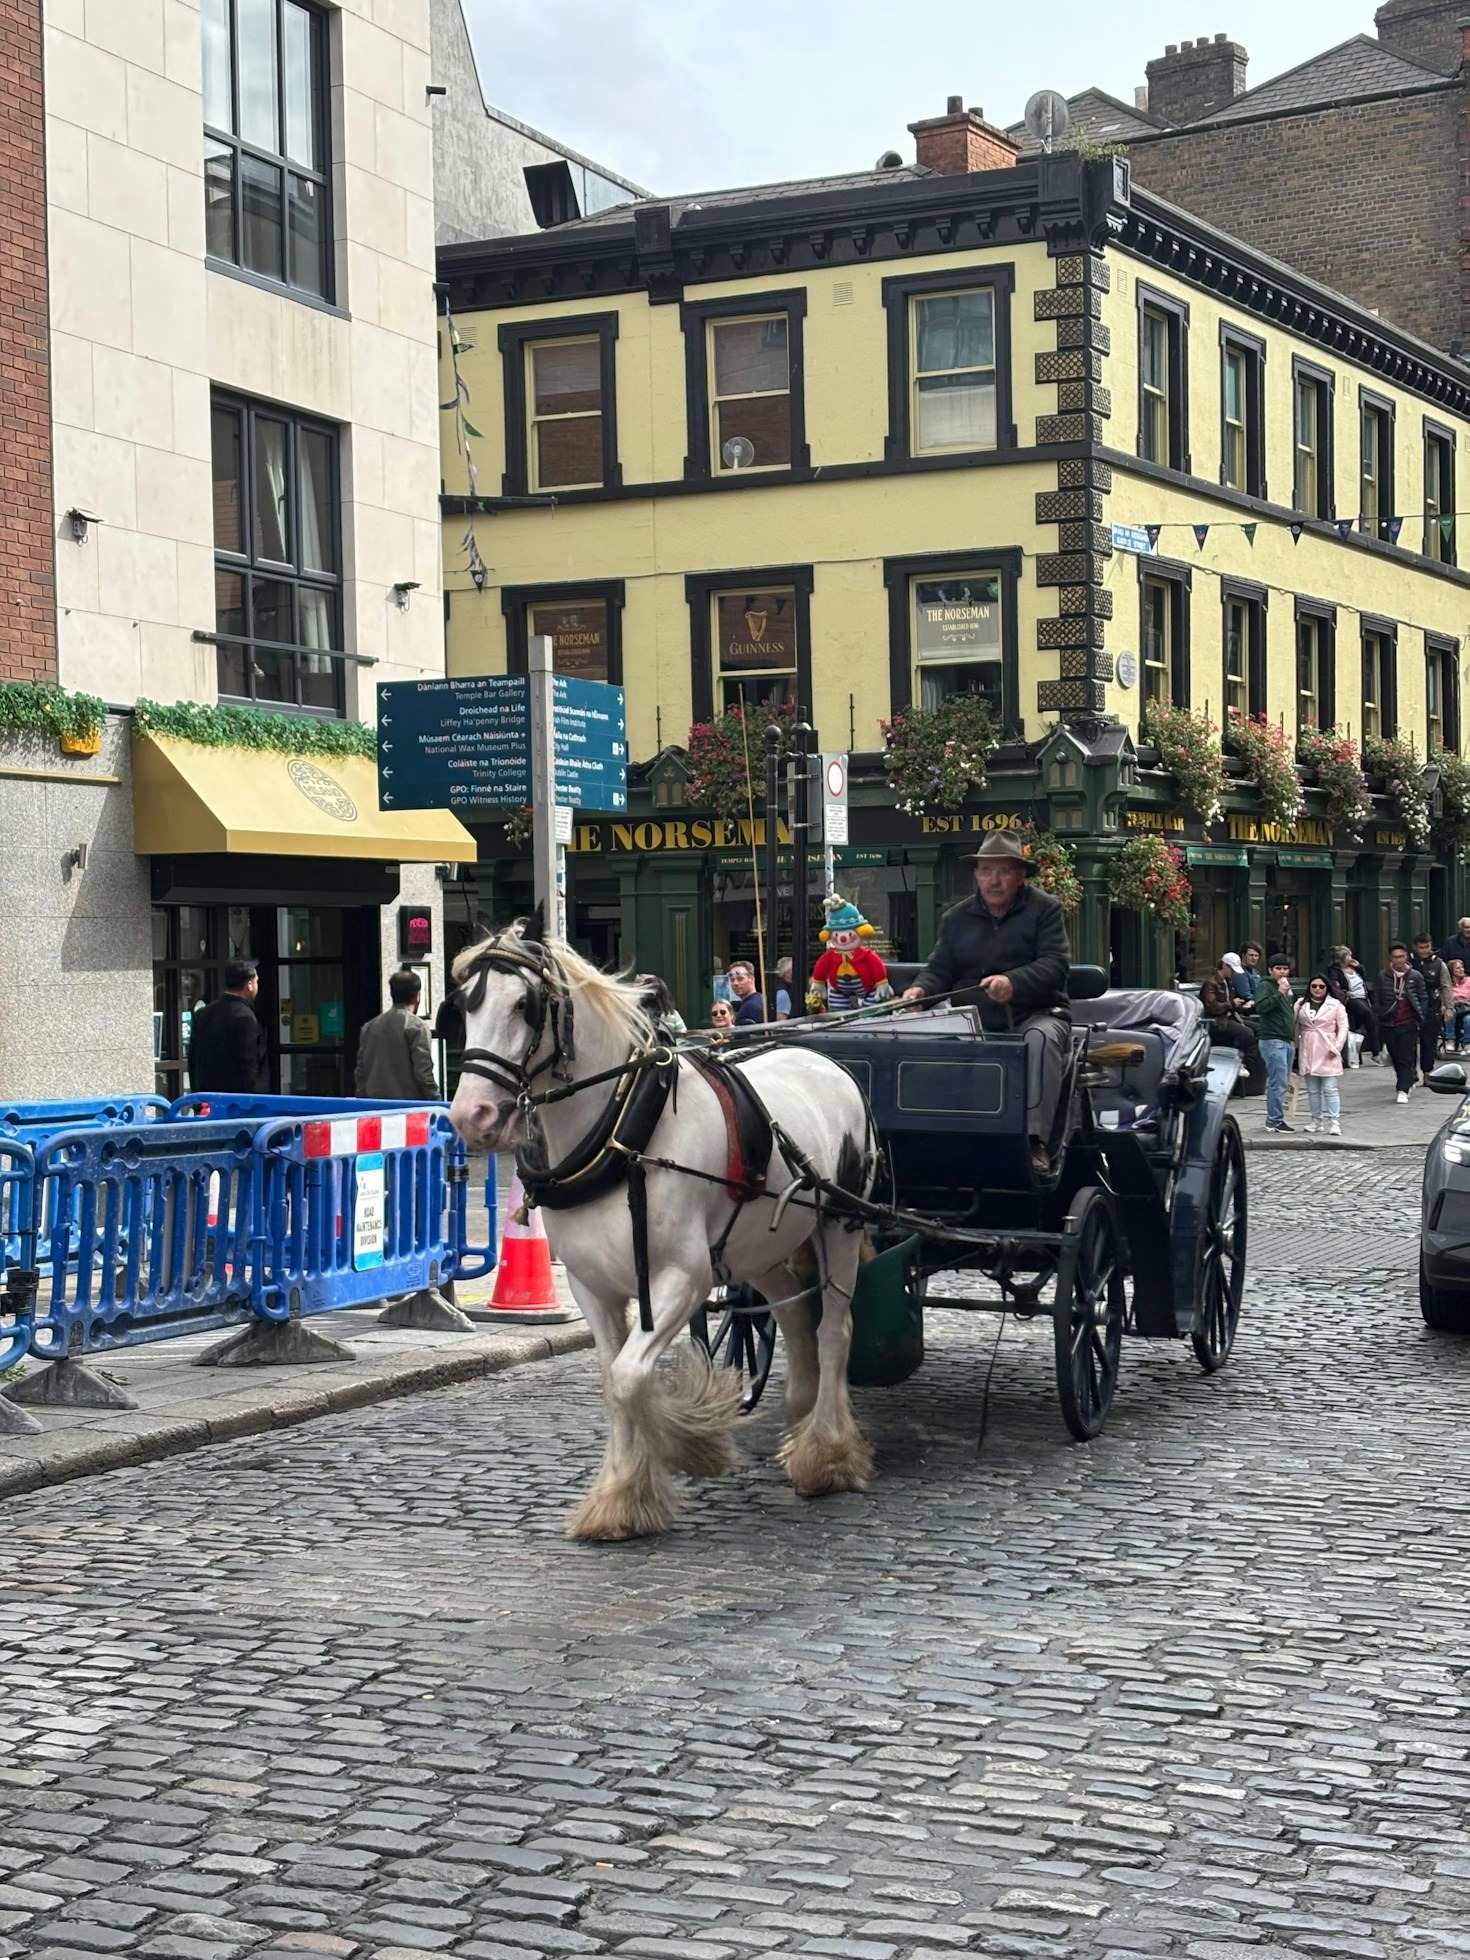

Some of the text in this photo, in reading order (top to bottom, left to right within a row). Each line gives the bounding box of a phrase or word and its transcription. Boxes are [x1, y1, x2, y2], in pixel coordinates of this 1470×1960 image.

[927, 606, 990, 622] THE NORSEMAN
[560, 633, 600, 646] NORSEMAN
[730, 641, 785, 655] GUINNESS
[417, 682, 448, 691] Dánlann
[450, 681, 475, 689] Bharra
[488, 677, 525, 687] Teampaill
[559, 679, 568, 688] Ark
[455, 689, 525, 700] Temple Bar Gallery
[559, 690, 568, 699] Ark
[459, 705, 498, 714] Droichead
[511, 703, 526, 712] Life
[440, 715, 526, 728] Liffey Ha'penny Bridge
[425, 741, 526, 754] National Wax Museum Plus
[448, 759, 478, 768] Coláiste
[472, 768, 527, 779] Trinity College
[450, 785, 469, 793] GPO:
[471, 784, 492, 792] Finné
[505, 783, 527, 791] Staire
[450, 795, 527, 804] GPO Witness History
[921, 812, 1022, 833] EST 1696
[610, 816, 797, 852] NORSEMA
[1228, 814, 1334, 846] THE NORSEMAN
[364, 1206, 374, 1218] ROAD
[356, 1219, 383, 1233] MAINTENANCE
[360, 1234, 377, 1247] DIVISION
